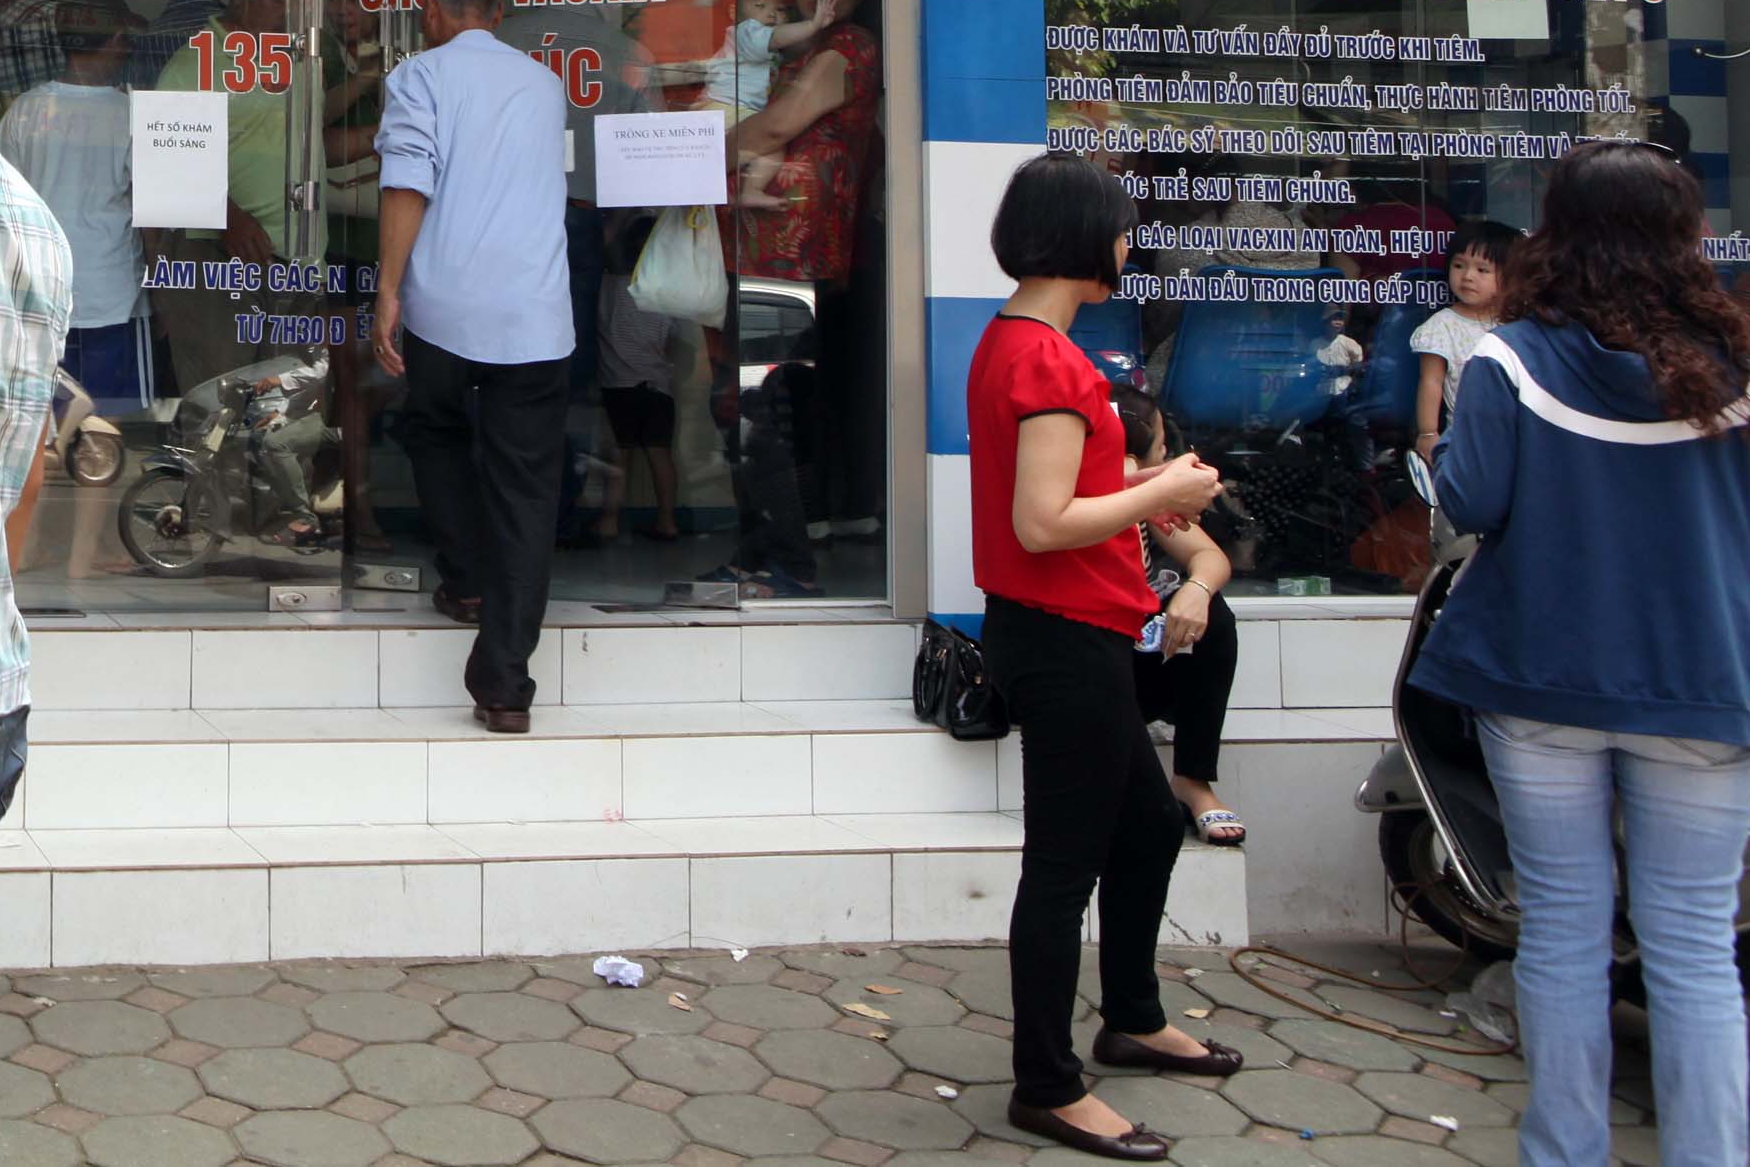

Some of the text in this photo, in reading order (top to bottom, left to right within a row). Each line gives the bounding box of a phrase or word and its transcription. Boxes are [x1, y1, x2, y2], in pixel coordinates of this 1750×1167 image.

[188, 30, 293, 95] 135
[1046, 24, 1485, 62] ĐƯỢC KHÁM VÀ TƯ VẤN ĐẦY ĐỦ TRƯỚC KHI TIÊM.
[1046, 70, 1636, 114] PHÒNG TIÊM ĐẢM BẢO TIÊU CHUẨN, THỰC HÀNH TIÊM PHÒNG TỐT.
[1046, 126, 1100, 156] ĐƯỢC
[1104, 123, 1143, 152] CÁC
[1147, 123, 1186, 153] BÁC
[1190, 124, 1216, 153] SỸ
[1219, 129, 1266, 154] THEO
[1271, 127, 1303, 155] DÕI
[1307, 130, 1345, 155] SAU
[1349, 127, 1395, 156] TIÊM
[1397, 132, 1428, 161] TẠI
[1432, 127, 1496, 158] PHÒNG
[1498, 128, 1546, 159] TIÊM
[1153, 167, 1356, 204] TRẺ SAU TIÊM CHỦNG.
[1137, 220, 1177, 250] CÁC
[1180, 225, 1224, 255] LOẠI
[1228, 227, 1296, 253] VACXIN
[1300, 230, 1329, 252] AN
[1333, 223, 1388, 256] TOÀN,
[1389, 225, 1435, 260] HIỆU
[202, 256, 262, 300] VIỆC
[268, 259, 323, 292] CÁC
[1165, 268, 1204, 301] DẪN
[1209, 269, 1248, 302] ĐẦU
[1253, 278, 1314, 302] TRONG
[1318, 278, 1370, 304] CUNG
[1373, 272, 1412, 303] CẤP
[234, 305, 324, 345] TỪ 7H30
